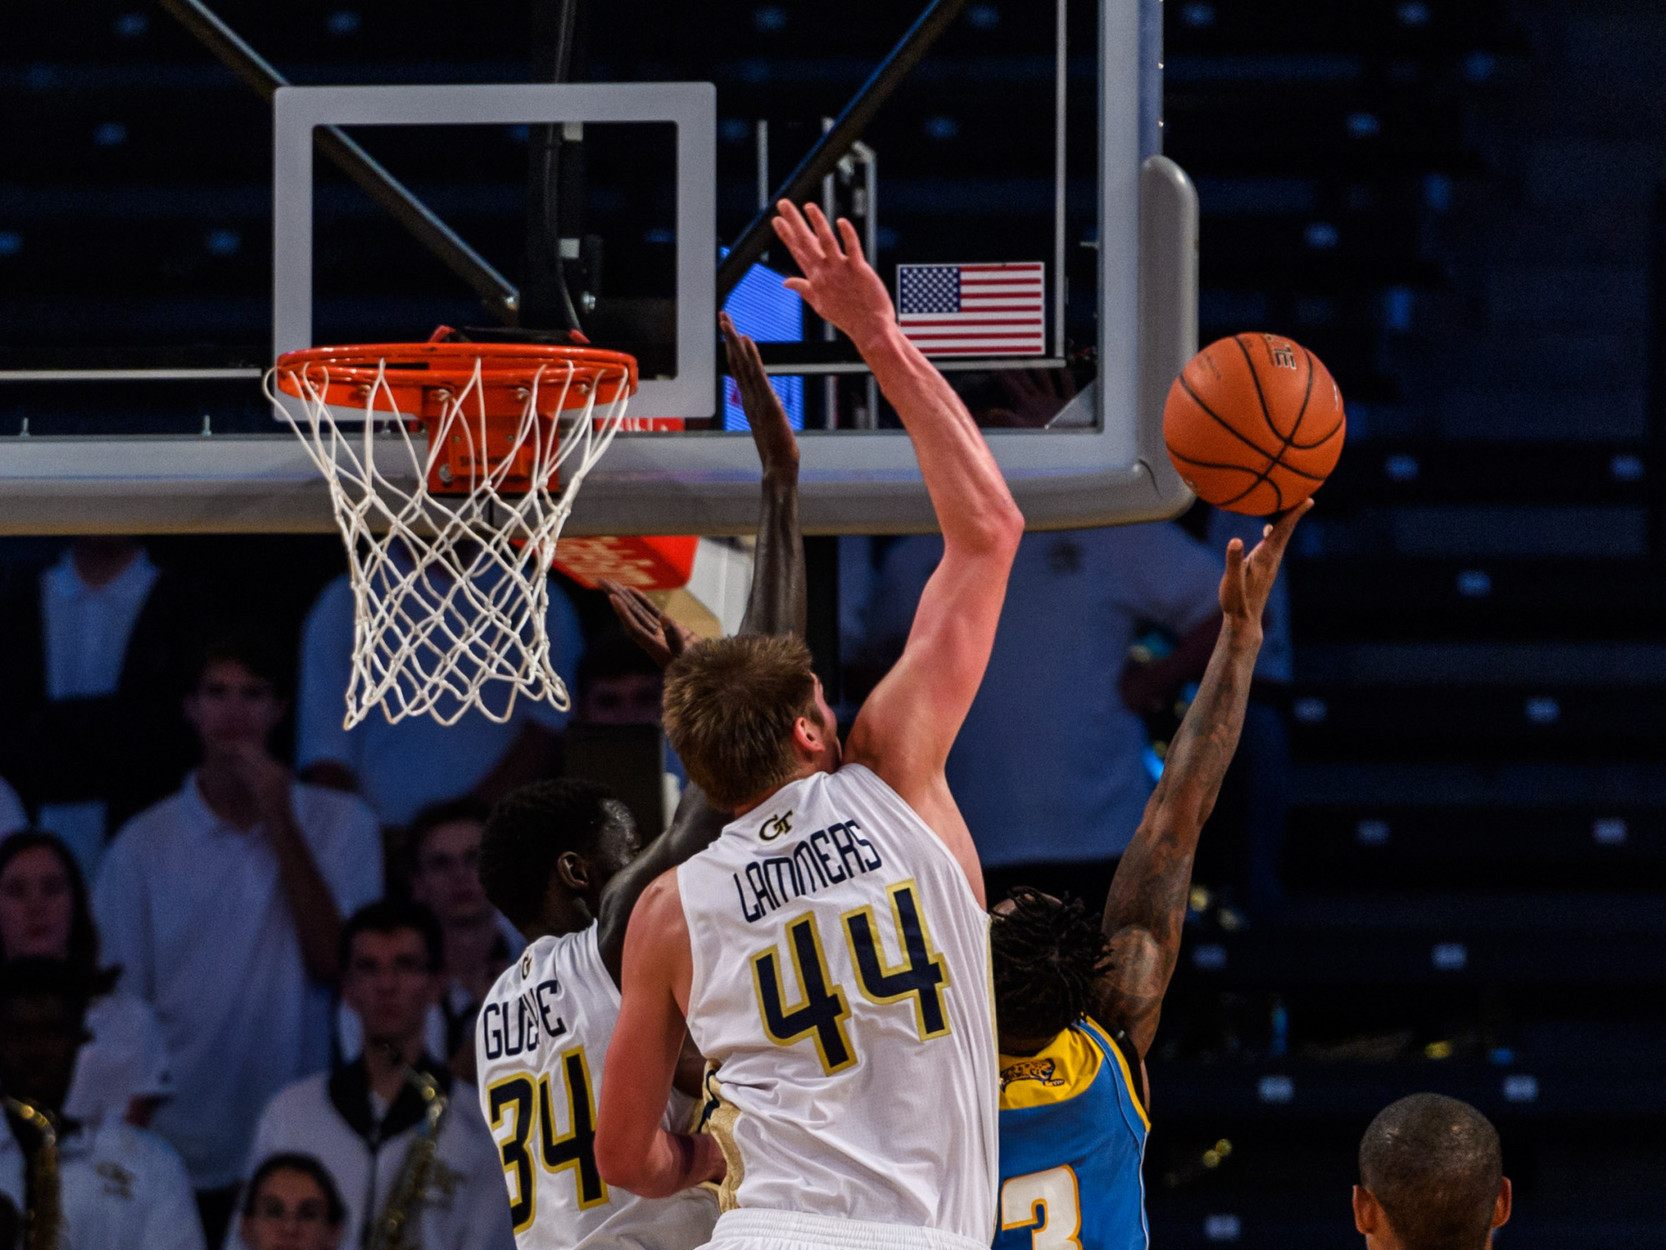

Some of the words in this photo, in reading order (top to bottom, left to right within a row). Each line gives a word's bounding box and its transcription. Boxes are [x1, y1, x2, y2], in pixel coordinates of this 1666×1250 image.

[734, 819, 882, 923] LAMMERS
[750, 879, 951, 1076] 44
[486, 1047, 609, 1234] 34
